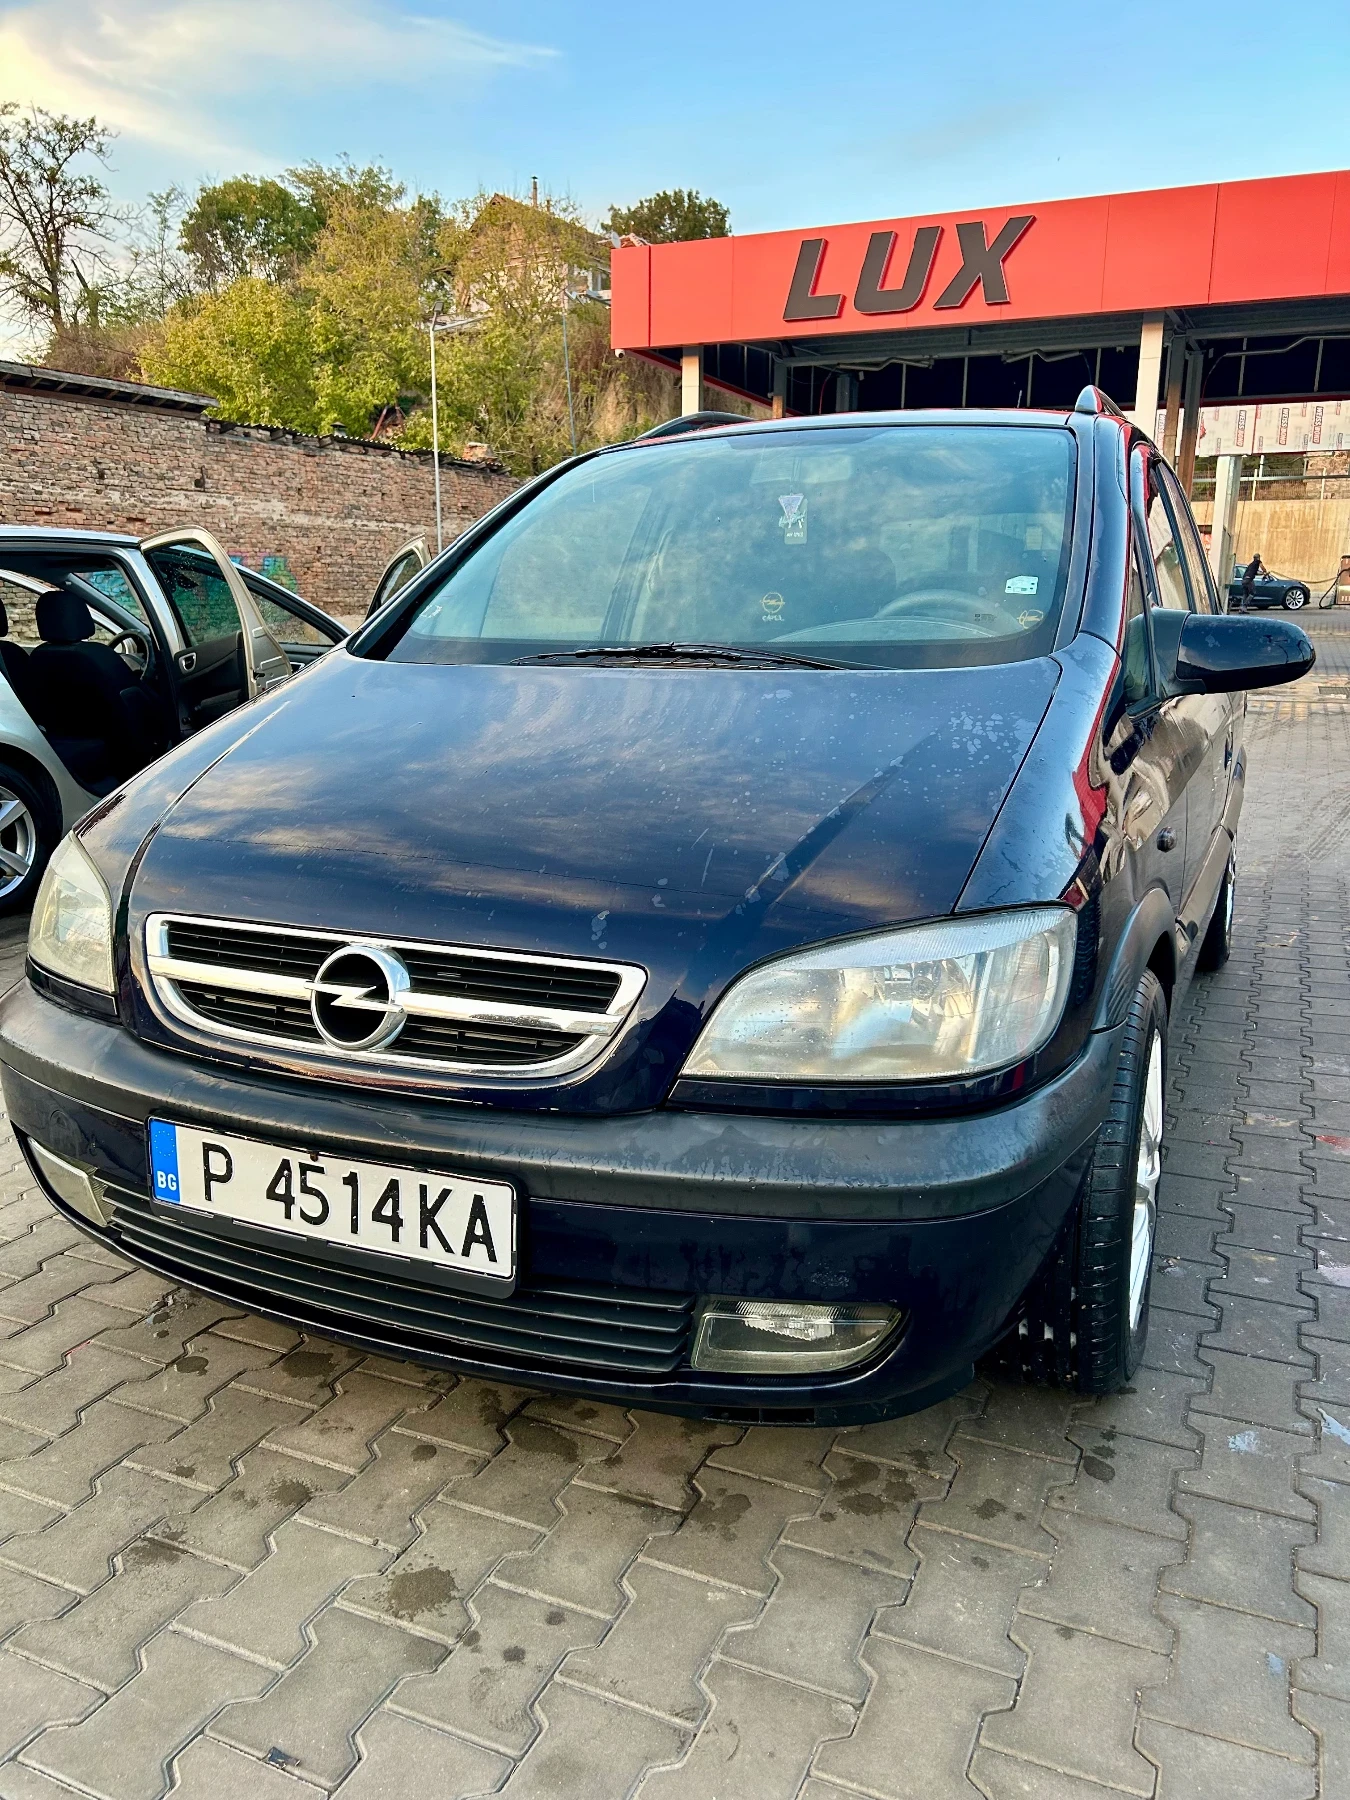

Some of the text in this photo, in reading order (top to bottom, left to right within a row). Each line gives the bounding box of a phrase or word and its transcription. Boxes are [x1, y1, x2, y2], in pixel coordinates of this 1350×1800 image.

[782, 214, 1037, 322] LUX
[1237, 410, 1247, 430] WEISS
[1281, 408, 1290, 428] WEISS
[1314, 406, 1324, 426] WEISS
[157, 1170, 177, 1191] BG
[202, 1142, 498, 1263] P 4514KA
